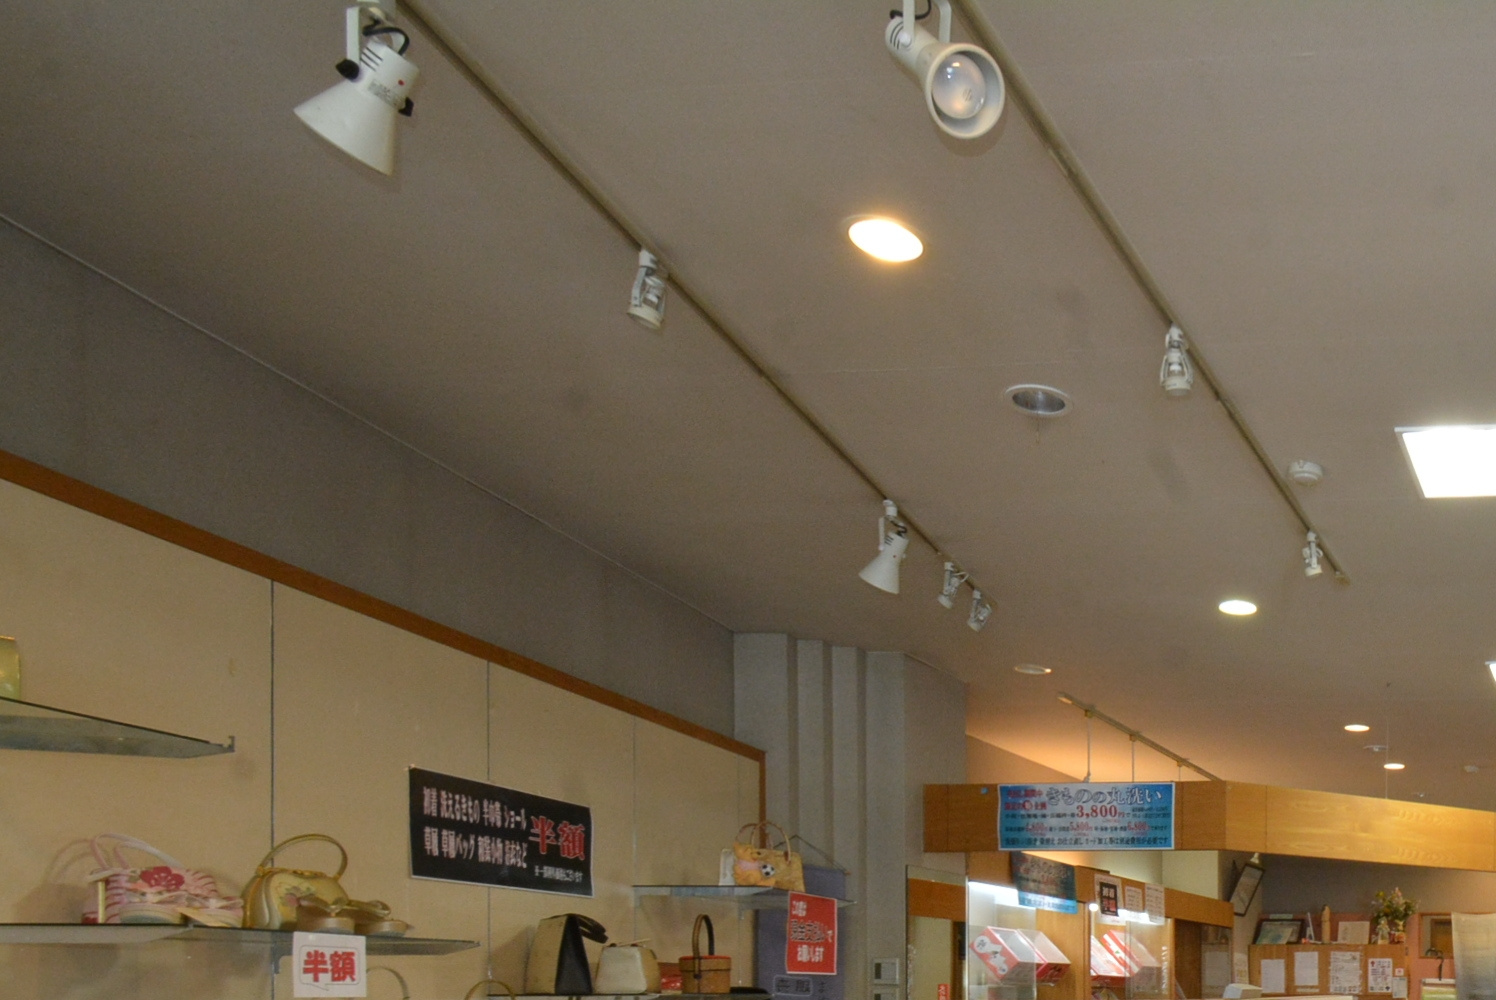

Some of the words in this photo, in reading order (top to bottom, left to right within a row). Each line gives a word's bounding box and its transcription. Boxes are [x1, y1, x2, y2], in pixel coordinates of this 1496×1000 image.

[1046, 787, 1162, 806] きものの丸洗い
[529, 815, 586, 861] 半額
[303, 950, 356, 982] 半額
